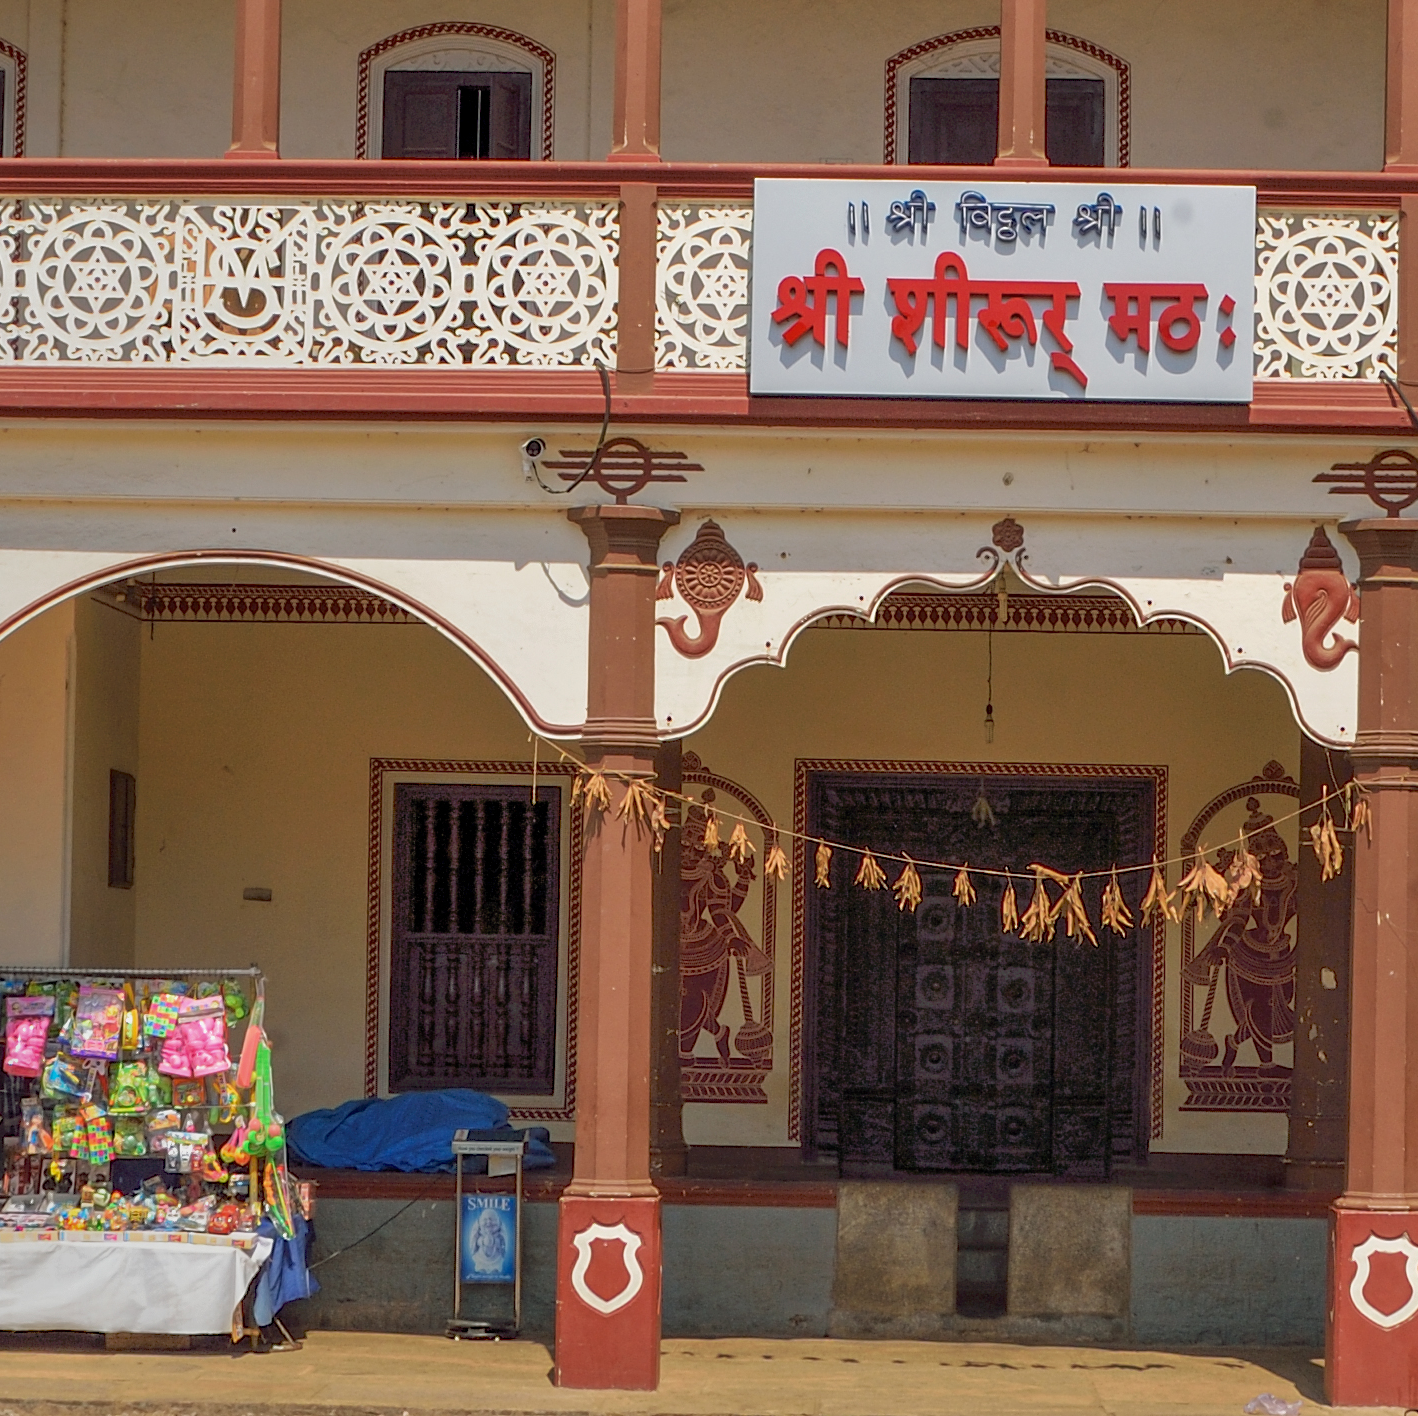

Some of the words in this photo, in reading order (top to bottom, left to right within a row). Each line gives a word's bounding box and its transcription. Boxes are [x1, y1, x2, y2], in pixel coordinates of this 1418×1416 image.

[886, 189, 936, 235] श्री
[1072, 191, 1123, 237] श्री
[770, 248, 866, 349] श्री
[467, 1196, 511, 1212] SMILE
